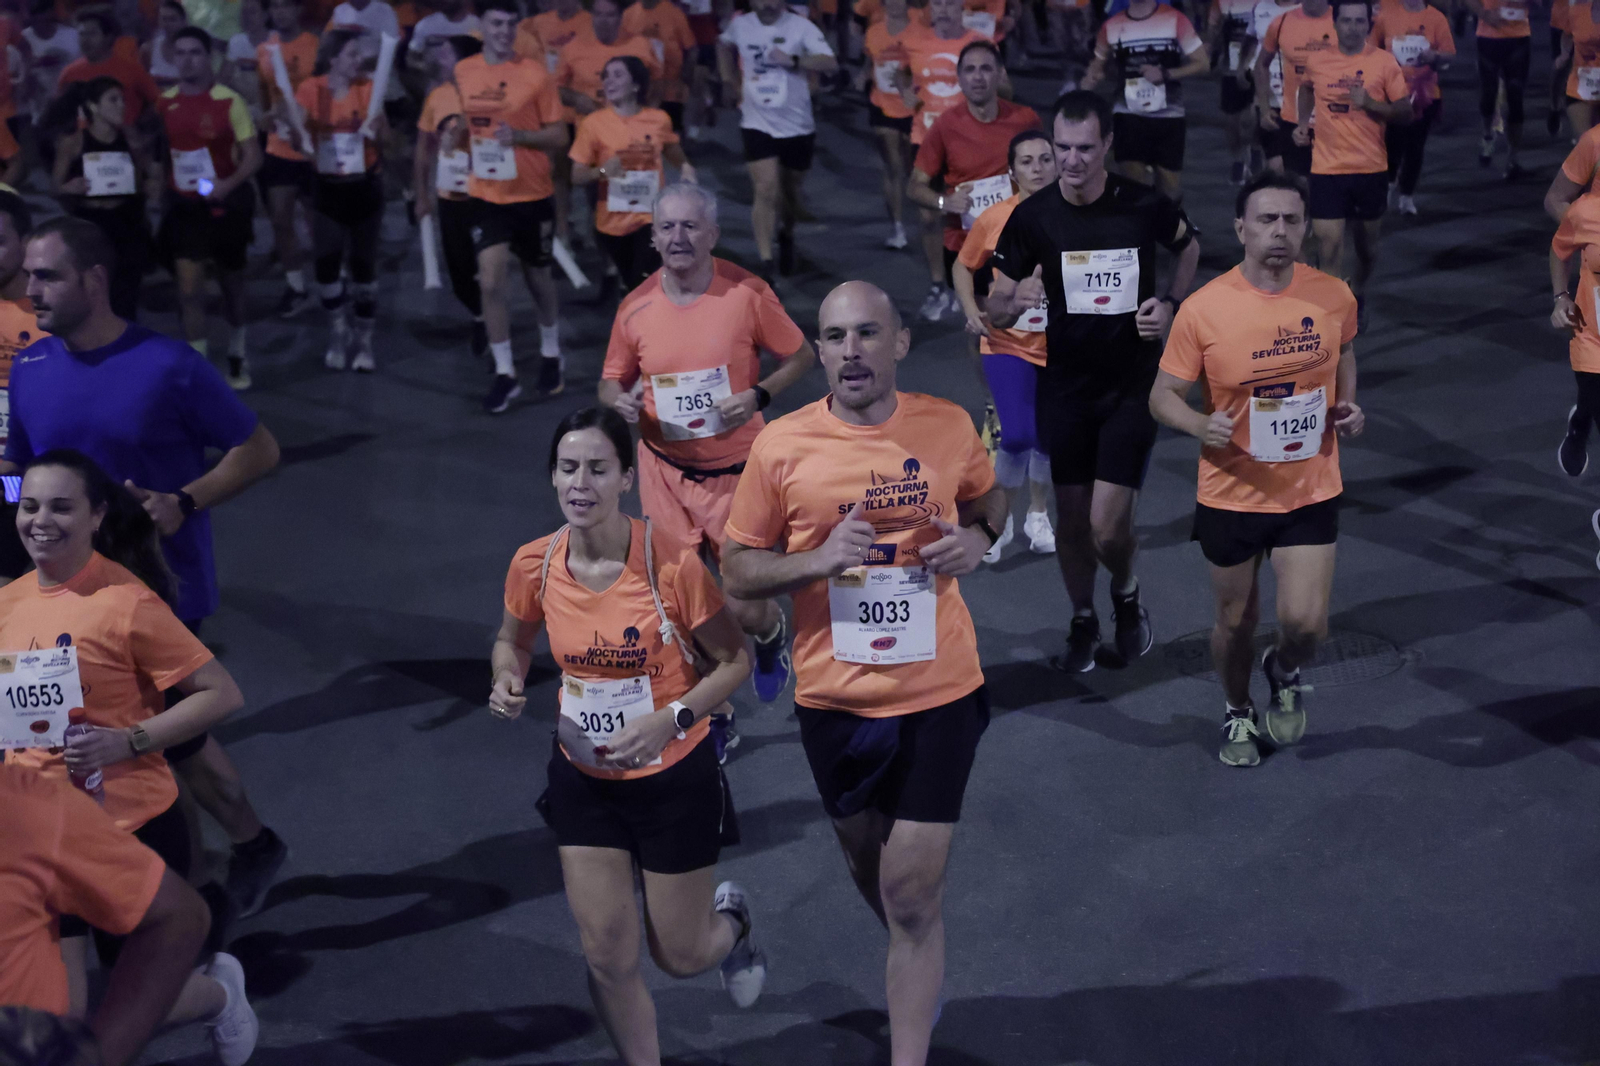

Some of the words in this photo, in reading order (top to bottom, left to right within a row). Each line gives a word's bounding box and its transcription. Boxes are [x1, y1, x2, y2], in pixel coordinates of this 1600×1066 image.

[1085, 272, 1121, 287] 7175
[1273, 333, 1321, 347] NOCTURNA
[1252, 346, 1295, 360] SEVILLA
[1297, 341, 1321, 353] KH7
[675, 392, 713, 412] 7363
[1270, 414, 1317, 436] 11240
[866, 481, 928, 498] NOCTURNA
[838, 498, 895, 514] SEILLA
[897, 491, 929, 507] KH7
[858, 600, 910, 624] 3033
[564, 654, 613, 668] SEVILLA
[616, 657, 647, 669] KH7
[587, 647, 647, 659] NOCTURNA
[6, 683, 64, 709] 10553
[580, 711, 625, 733] 3031
